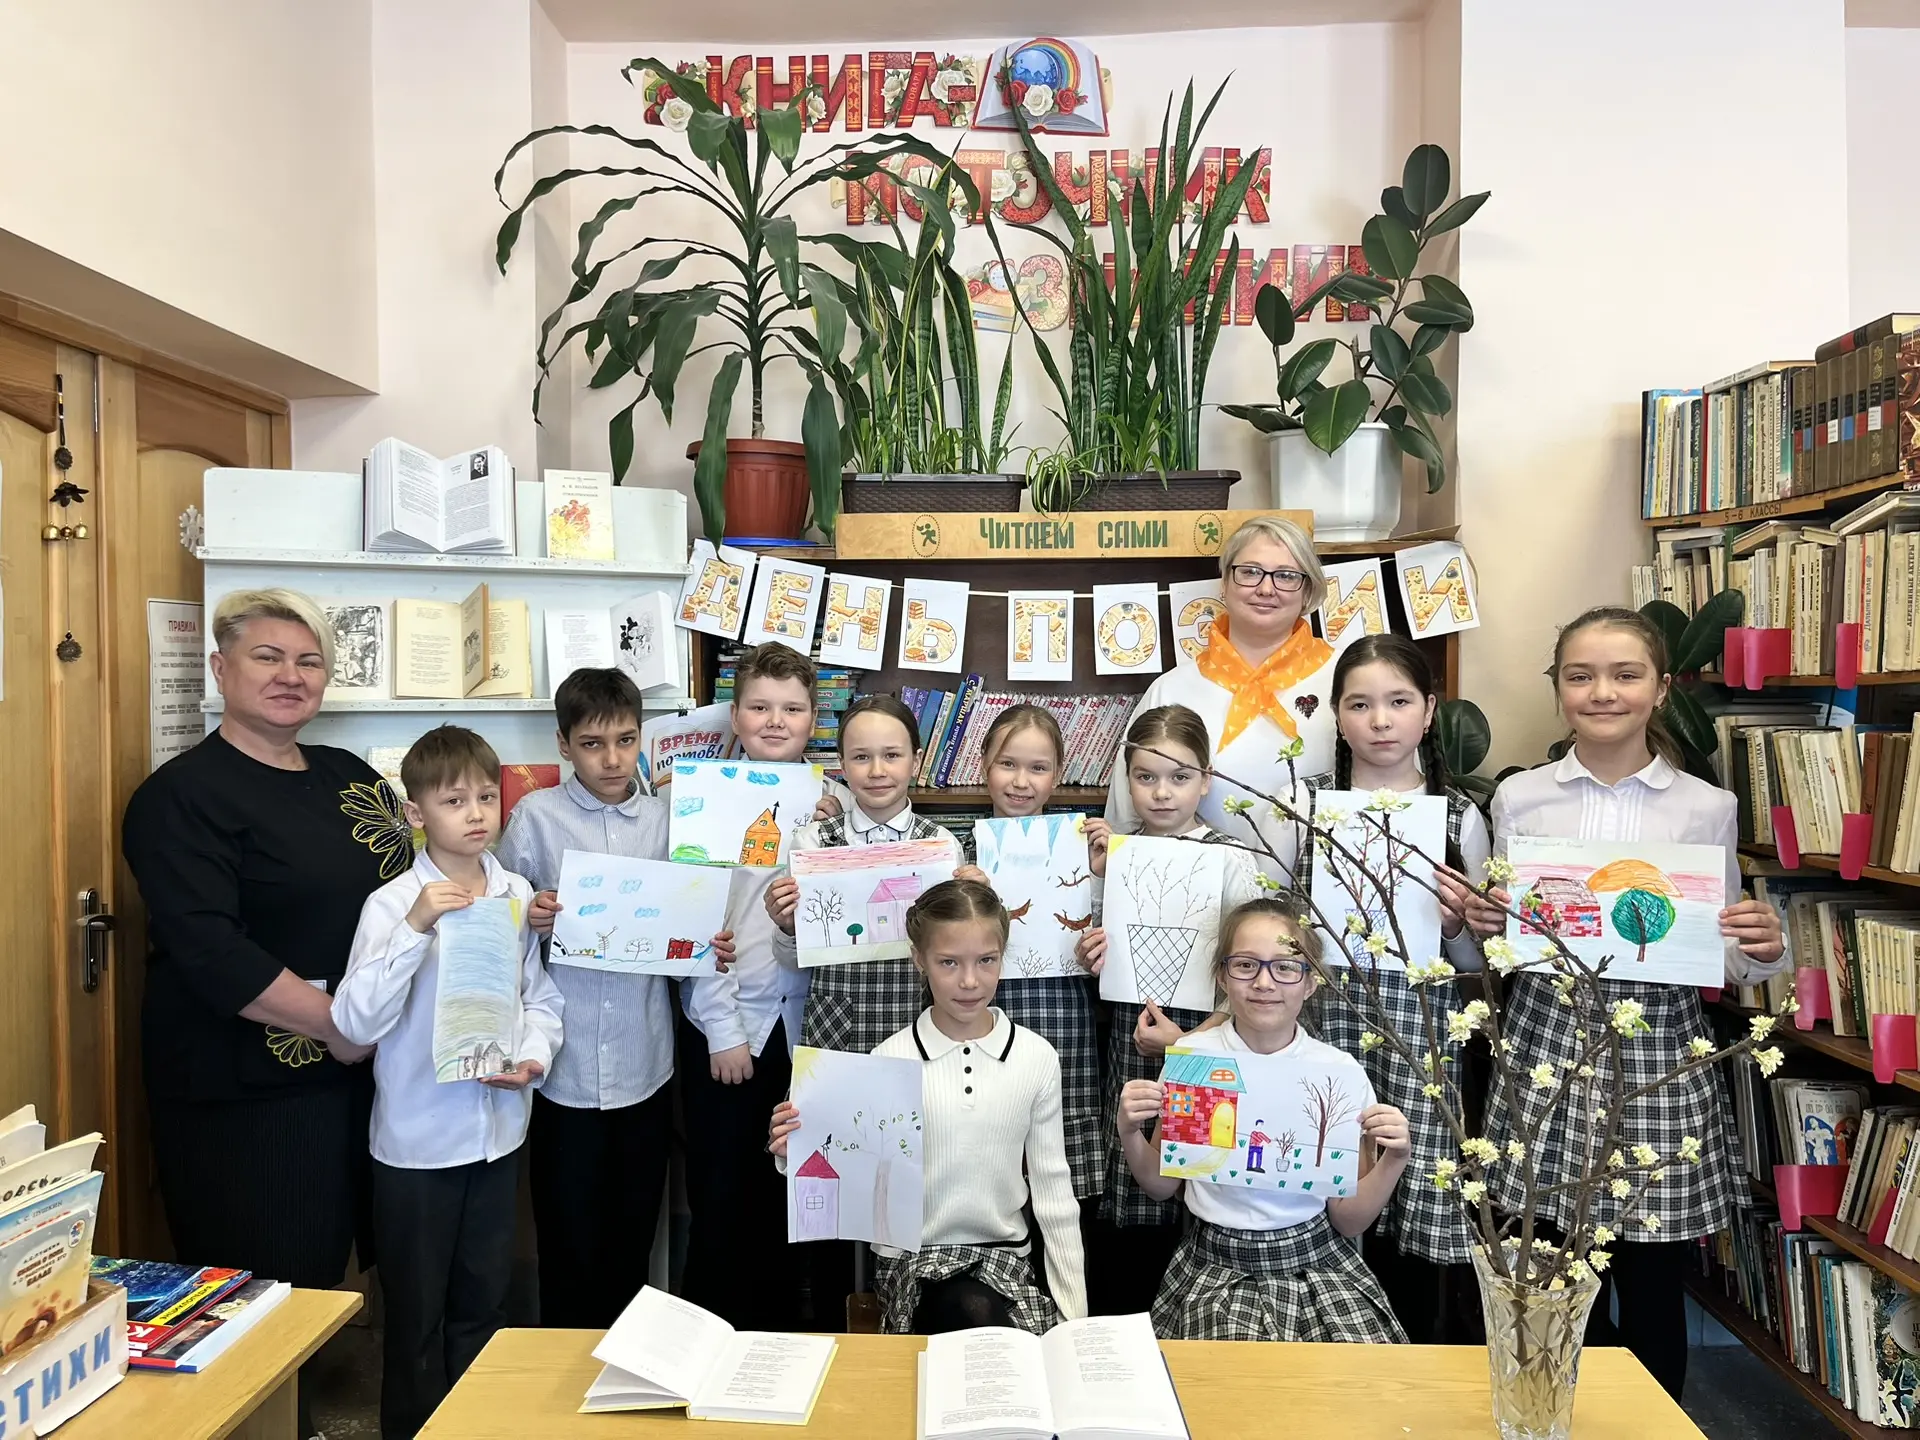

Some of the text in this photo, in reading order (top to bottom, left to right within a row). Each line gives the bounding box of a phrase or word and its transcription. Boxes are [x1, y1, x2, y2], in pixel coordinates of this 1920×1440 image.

[1750, 503, 1782, 518] КЛАССЫ
[980, 518, 1168, 550] ЧИТАЕМ САМИ
[1907, 544, 1915, 576] АКТЕРЫ
[681, 558, 957, 665] ДЕНЬ
[1014, 555, 1473, 665] ПОЭИИ
[168, 620, 197, 632] ПРАВИЛА
[956, 687, 973, 725] МАРШАК
[659, 731, 723, 753] ВРЕМЯ
[1756, 743, 1764, 766] ПОЛКА
[0, 1174, 62, 1203] ОВСК
[32, 1199, 63, 1218] ПУШКИН
[26, 1267, 53, 1287] БАЛДЕ
[0, 1325, 111, 1437] ТИХИ
